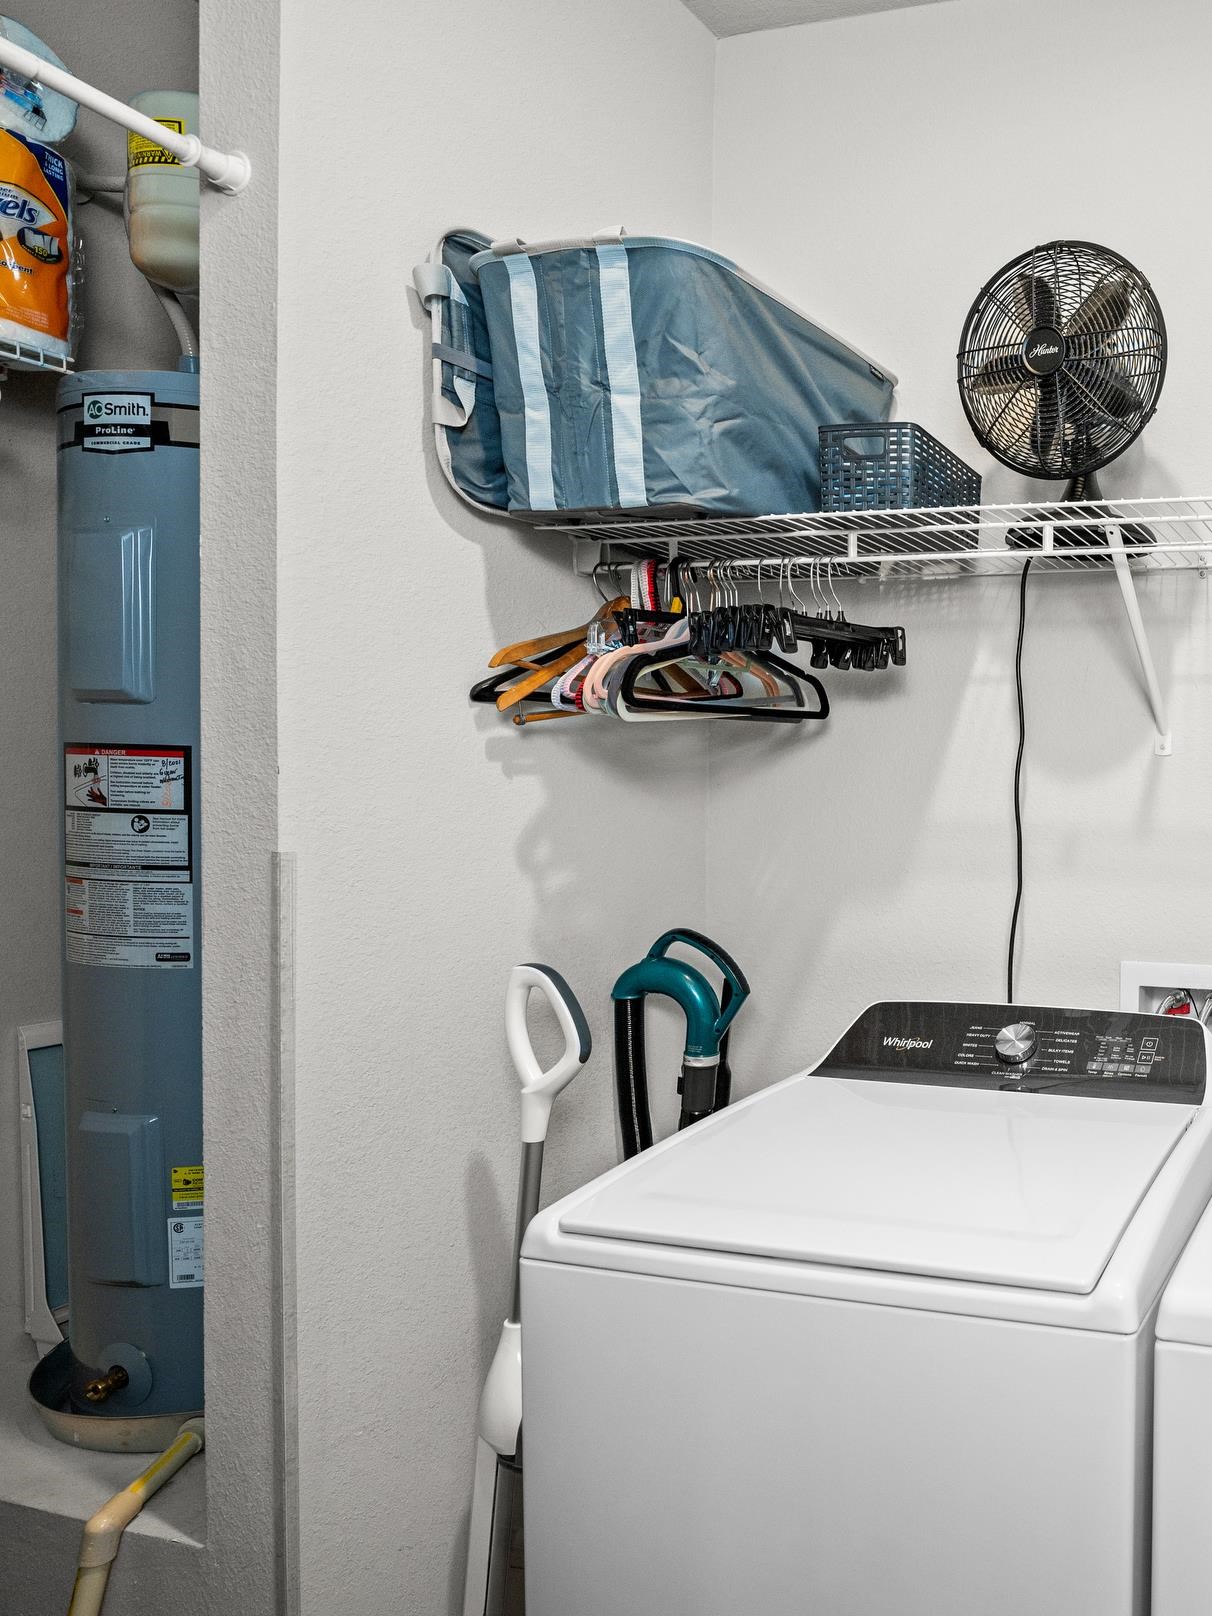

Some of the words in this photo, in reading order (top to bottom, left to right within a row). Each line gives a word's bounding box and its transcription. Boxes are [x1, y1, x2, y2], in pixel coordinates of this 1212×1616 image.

[44, 151, 64, 169] THICK
[43, 166, 64, 181] LASTING
[48, 164, 64, 176] LONG
[34, 246, 48, 257] 150
[1029, 343, 1059, 358] Hunter
[883, 1036, 934, 1050] Whirlpool
